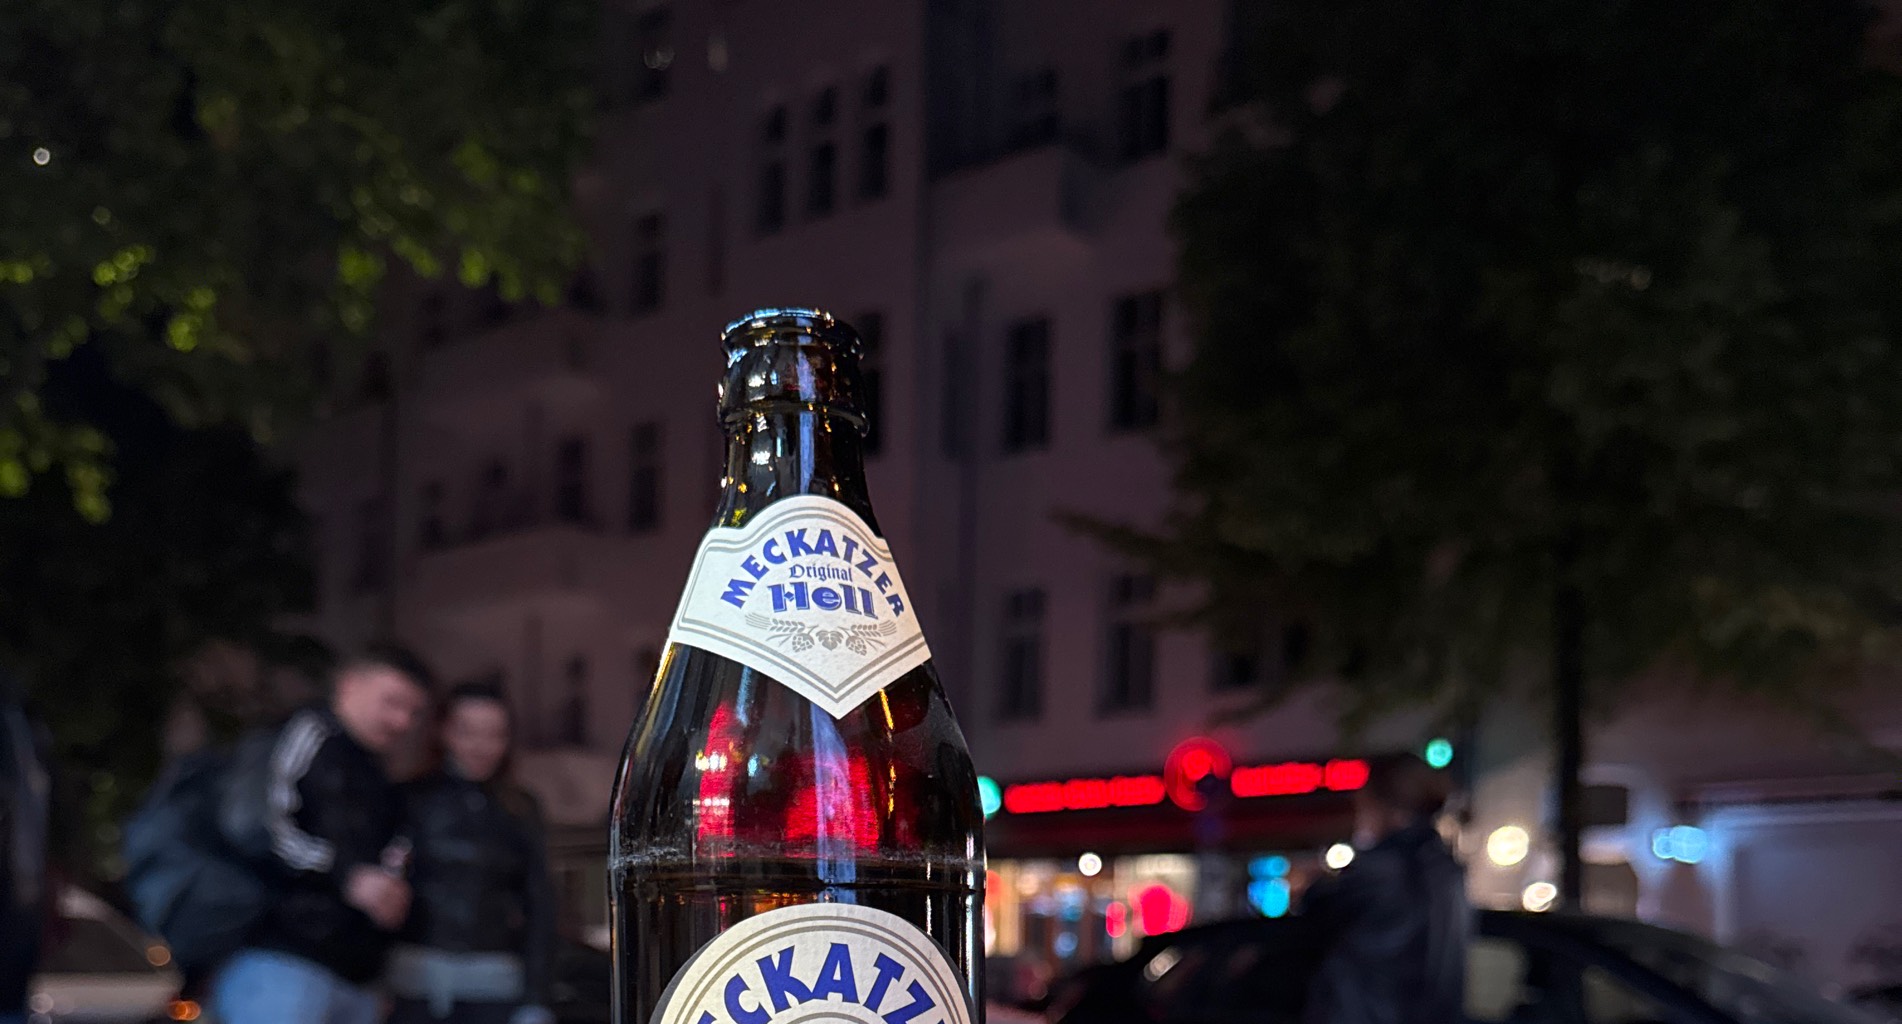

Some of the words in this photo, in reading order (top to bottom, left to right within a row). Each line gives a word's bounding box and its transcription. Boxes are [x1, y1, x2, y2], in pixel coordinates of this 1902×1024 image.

[720, 528, 905, 618] MECKATZER
[789, 563, 853, 582] Original
[767, 581, 879, 620] Hell
